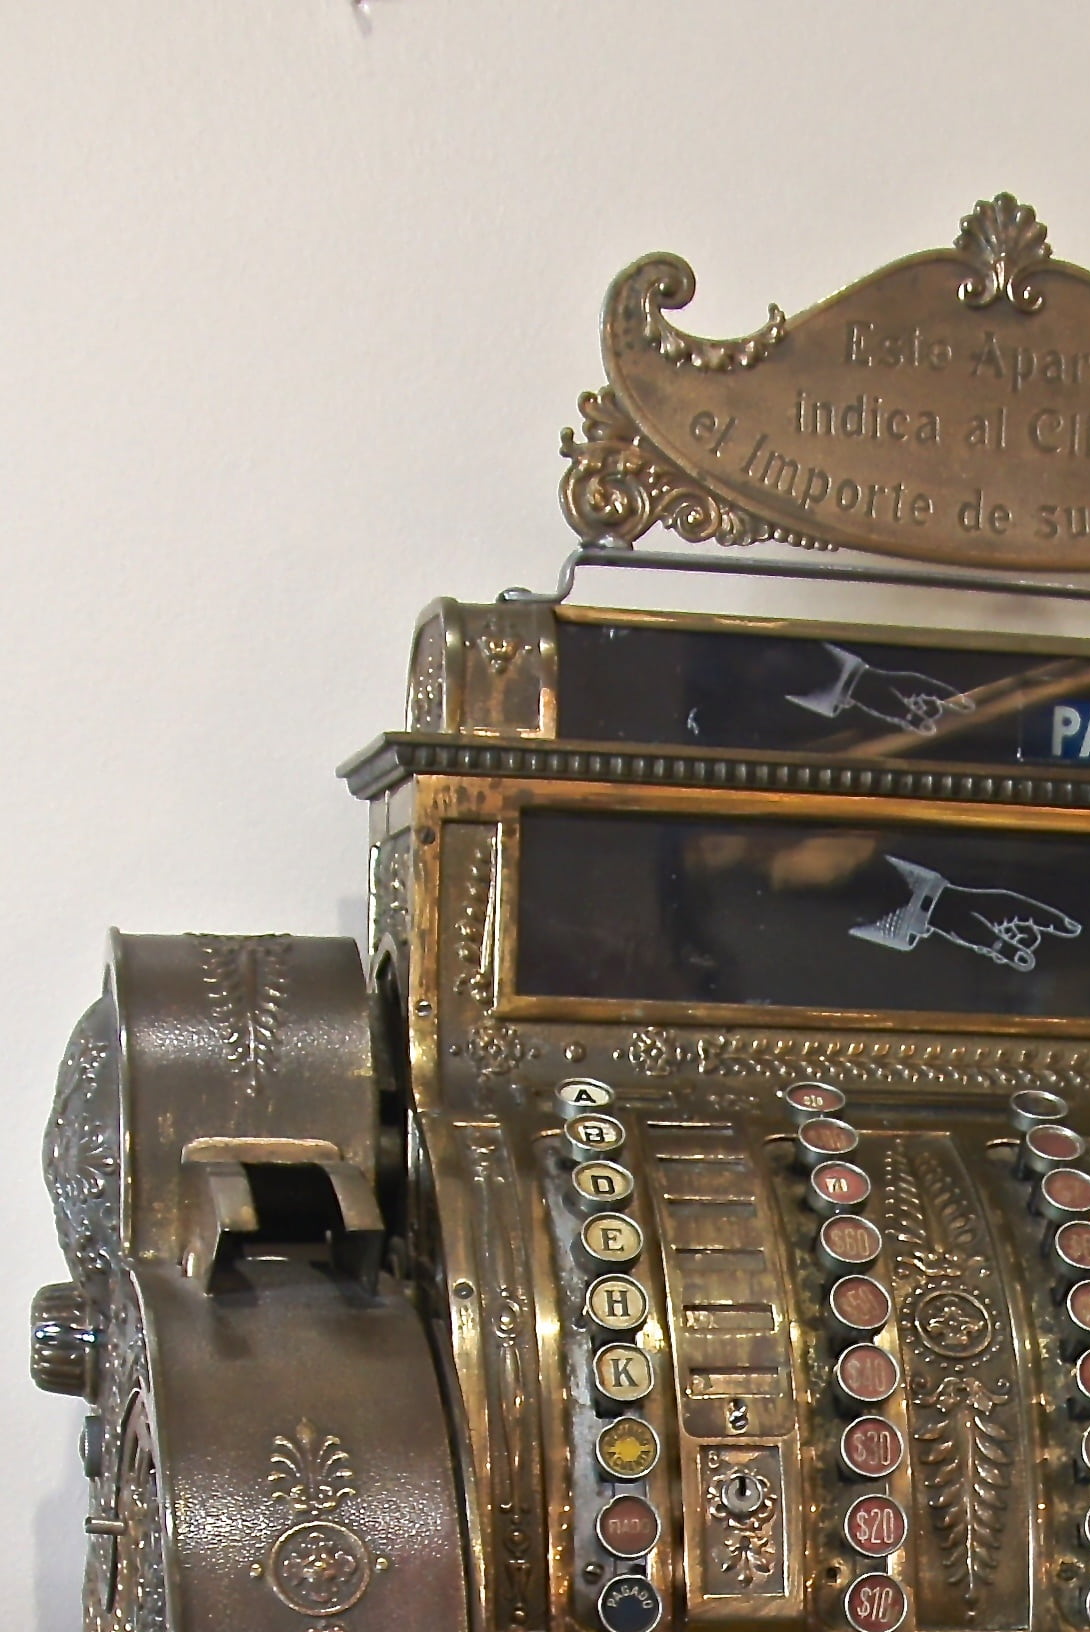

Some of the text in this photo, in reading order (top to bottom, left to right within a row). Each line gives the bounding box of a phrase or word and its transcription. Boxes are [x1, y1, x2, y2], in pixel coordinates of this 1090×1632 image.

[844, 320, 953, 371] Este
[966, 404, 1007, 449] al
[689, 409, 736, 458] el
[957, 488, 1013, 535] de
[1035, 503, 1090, 539] su
[574, 1088, 597, 1104] A
[590, 1174, 616, 1195] D
[599, 1227, 625, 1252] E
[603, 1289, 632, 1318] H
[609, 1357, 639, 1388] K
[852, 1431, 892, 1466] $30
[856, 1508, 895, 1544] $20
[606, 1585, 655, 1609] PAGADO
[856, 1586, 894, 1623] $10
